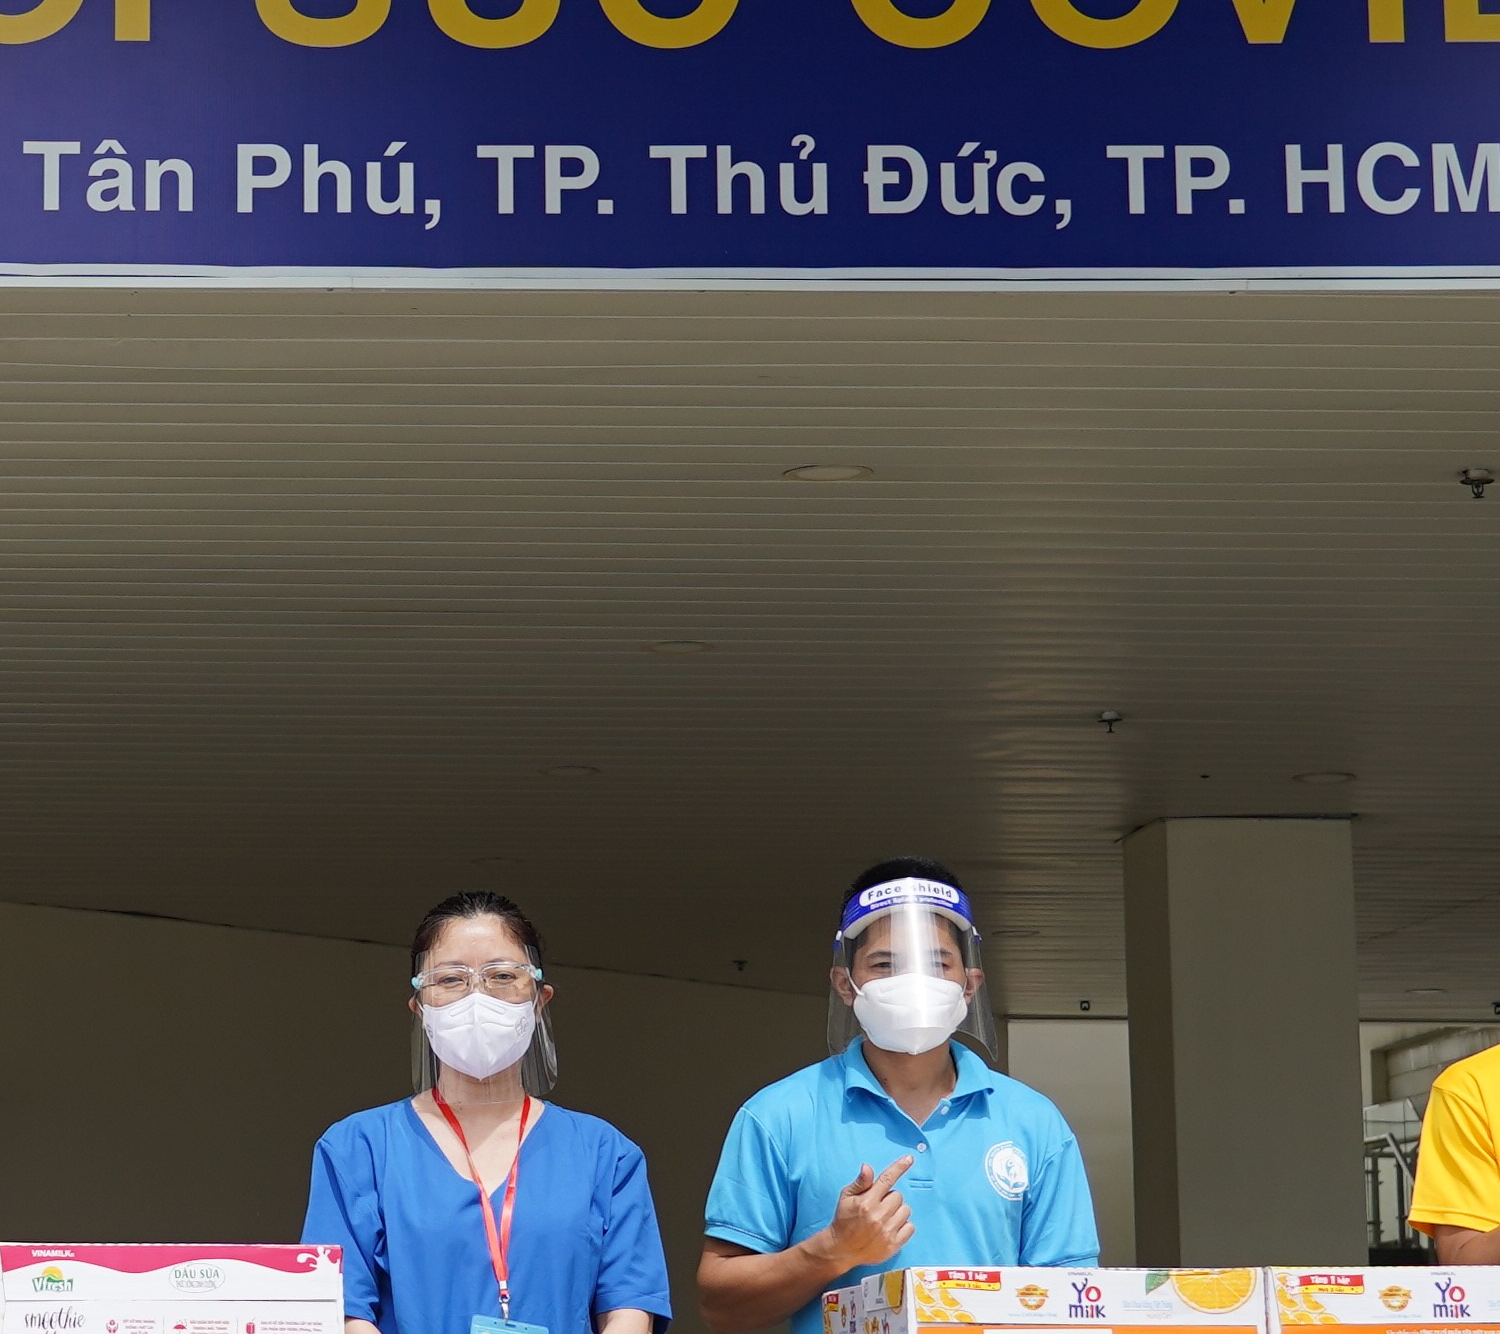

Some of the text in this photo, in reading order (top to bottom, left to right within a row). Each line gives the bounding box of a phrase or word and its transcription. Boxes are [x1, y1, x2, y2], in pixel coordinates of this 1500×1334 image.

[22, 139, 194, 212] Tân
[237, 139, 442, 229] Phú,
[477, 145, 614, 216] TP.
[649, 134, 829, 215] Thủ
[864, 142, 1073, 229] Đức,
[1107, 145, 1245, 214] TP.
[868, 883, 952, 901] Face hield
